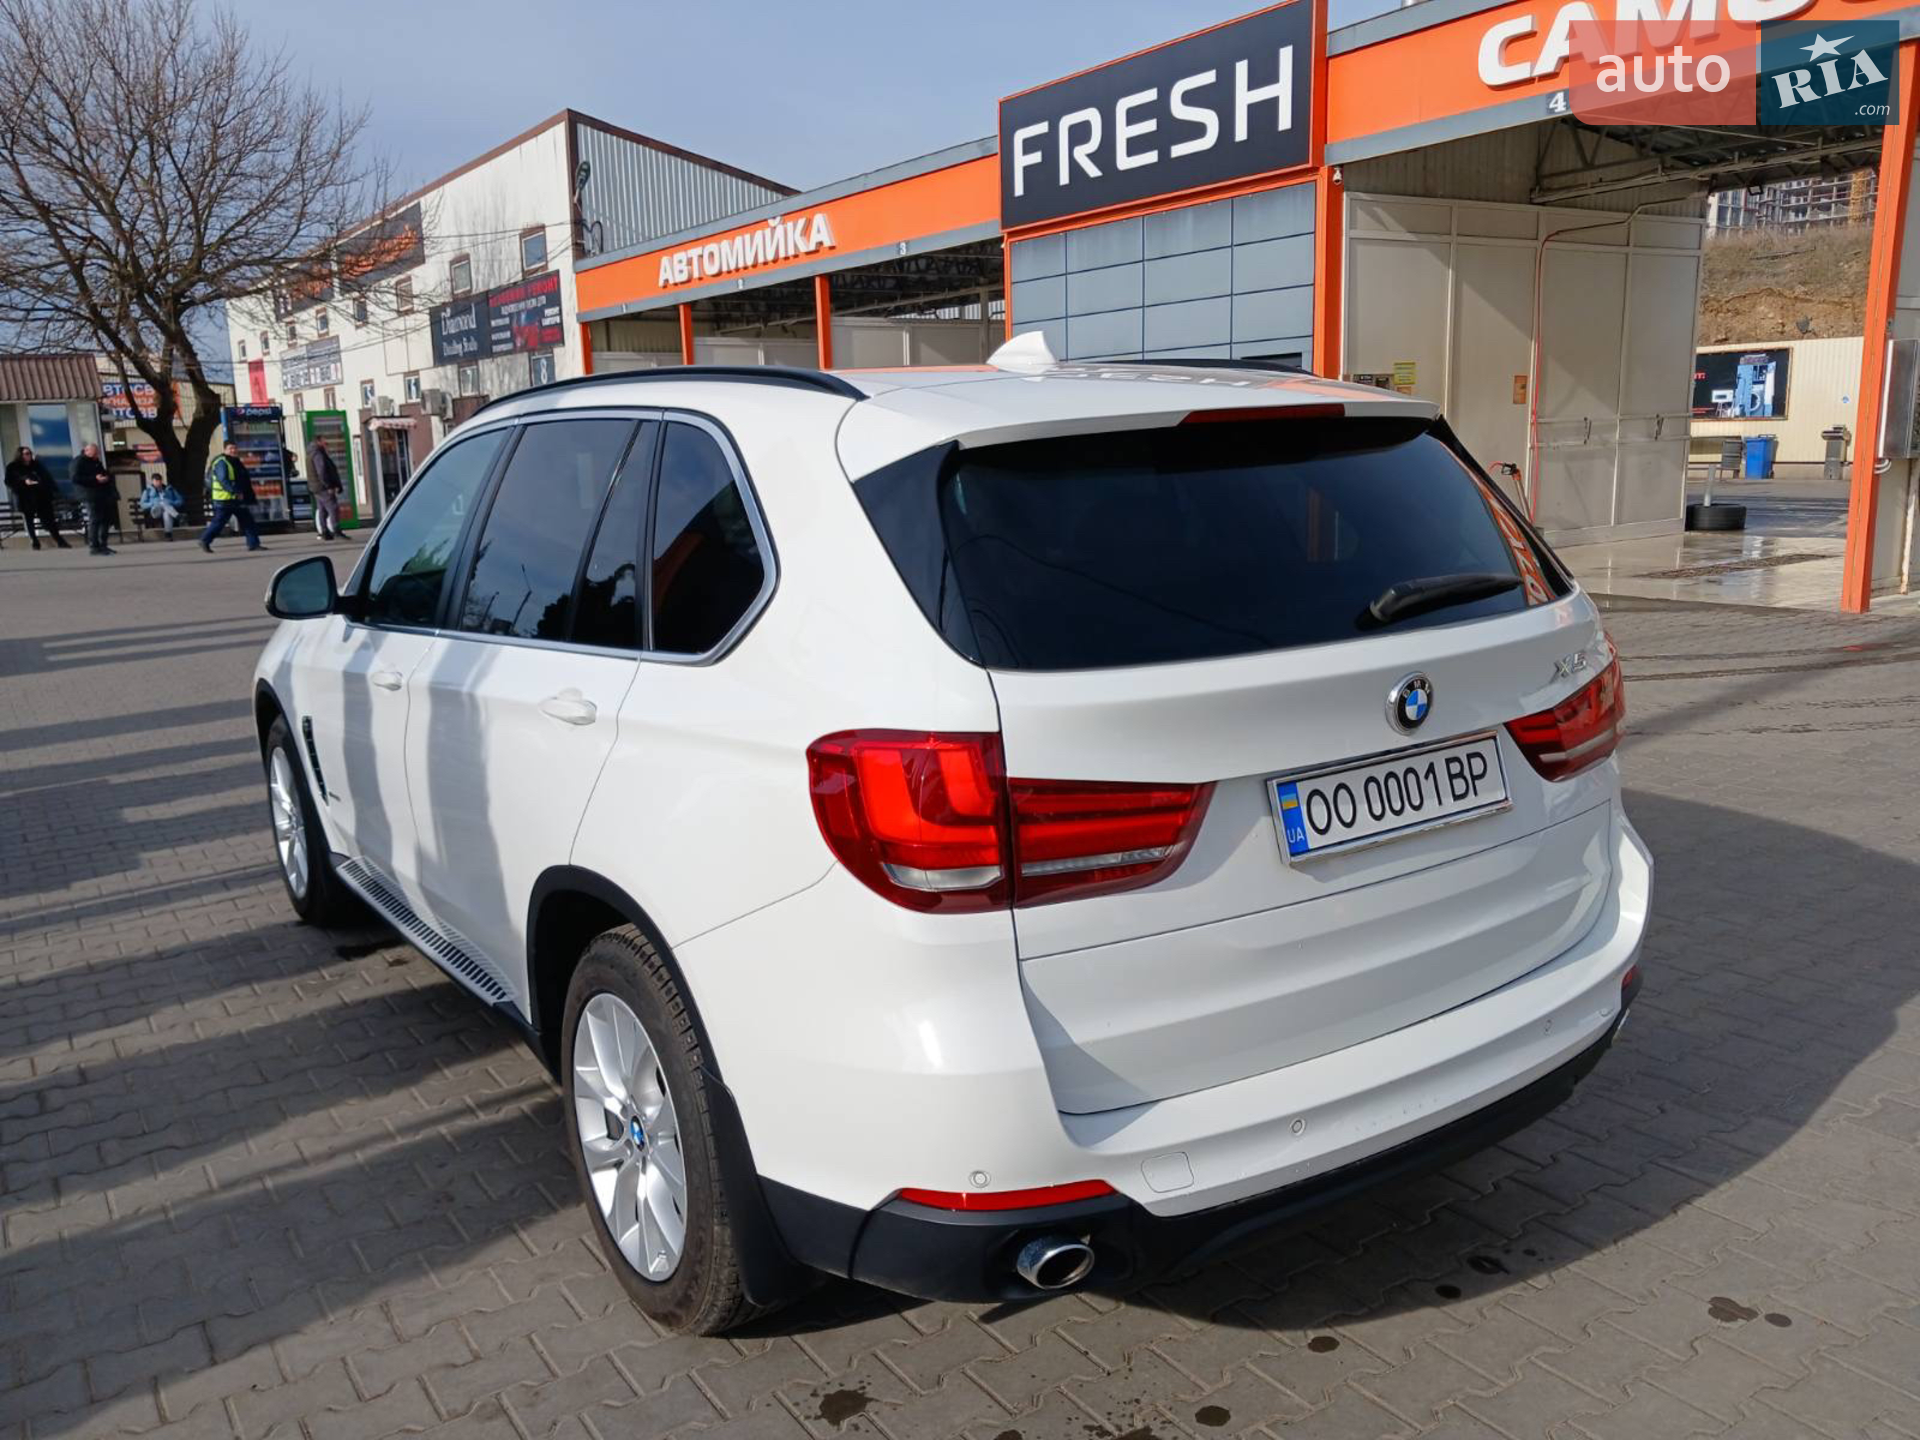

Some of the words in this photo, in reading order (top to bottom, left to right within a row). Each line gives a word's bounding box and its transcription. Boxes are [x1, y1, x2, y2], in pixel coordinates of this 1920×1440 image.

[1013, 45, 1293, 197] FRESH
[1549, 91, 1567, 113] 4
[658, 213, 835, 287] АВТОМИЙКА
[540, 358, 548, 384] 8
[1306, 782, 1357, 835] OO
[1364, 761, 1443, 822] 0001
[1445, 751, 1488, 801] BP
[1287, 829, 1305, 844] UA
